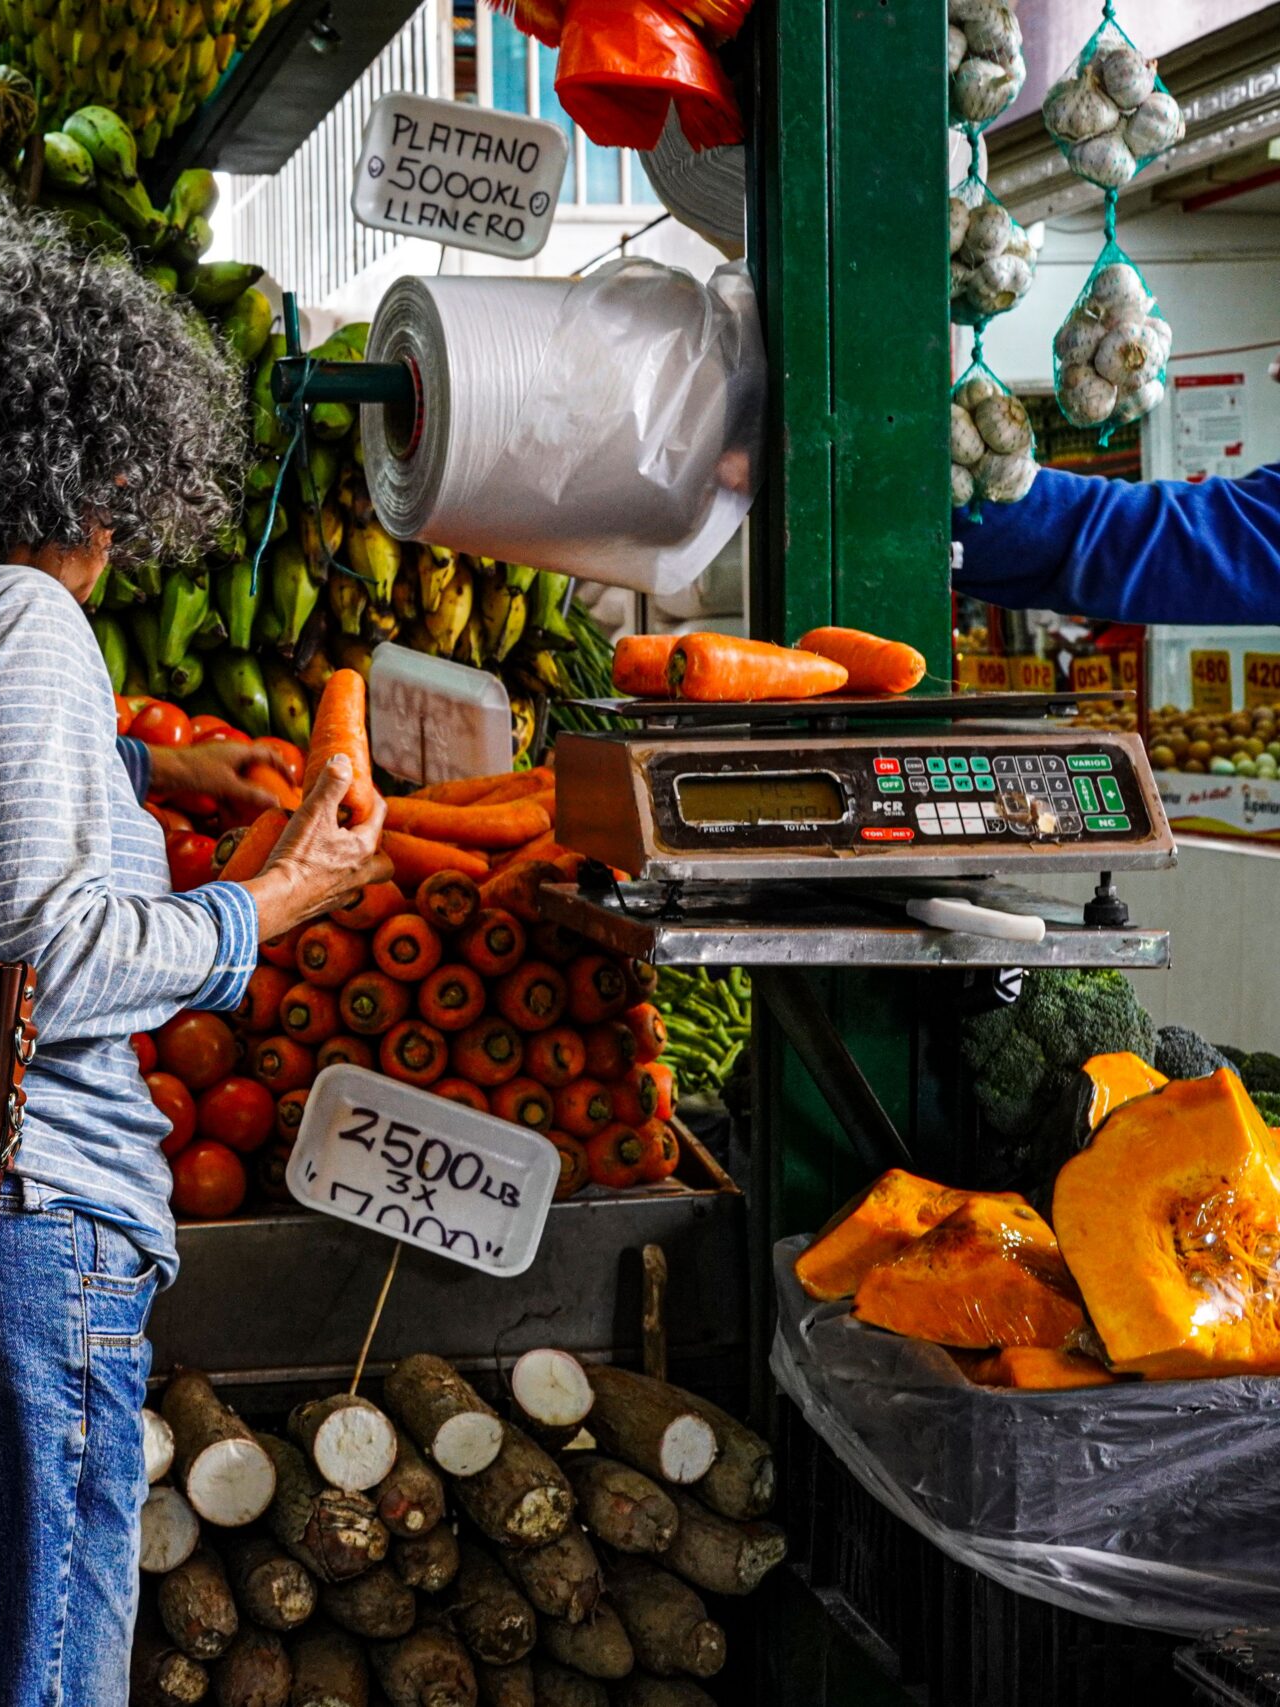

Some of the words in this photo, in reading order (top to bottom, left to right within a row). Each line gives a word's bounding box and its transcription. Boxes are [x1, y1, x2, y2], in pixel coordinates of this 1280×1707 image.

[392, 113, 540, 173] PLATANO
[384, 198, 524, 242] LLANERO
[1194, 658, 1228, 683] 480
[1000, 761, 1007, 770] 7
[1025, 761, 1033, 770] 8
[1049, 760, 1057, 770] 9
[1007, 781, 1014, 790] 4
[1030, 781, 1039, 790] 5
[1055, 781, 1063, 789] 6
[872, 801, 903, 812] PCR
[1060, 799, 1069, 809] 3
[1098, 819, 1116, 827] NC
[784, 824, 809, 832] TOTAL
